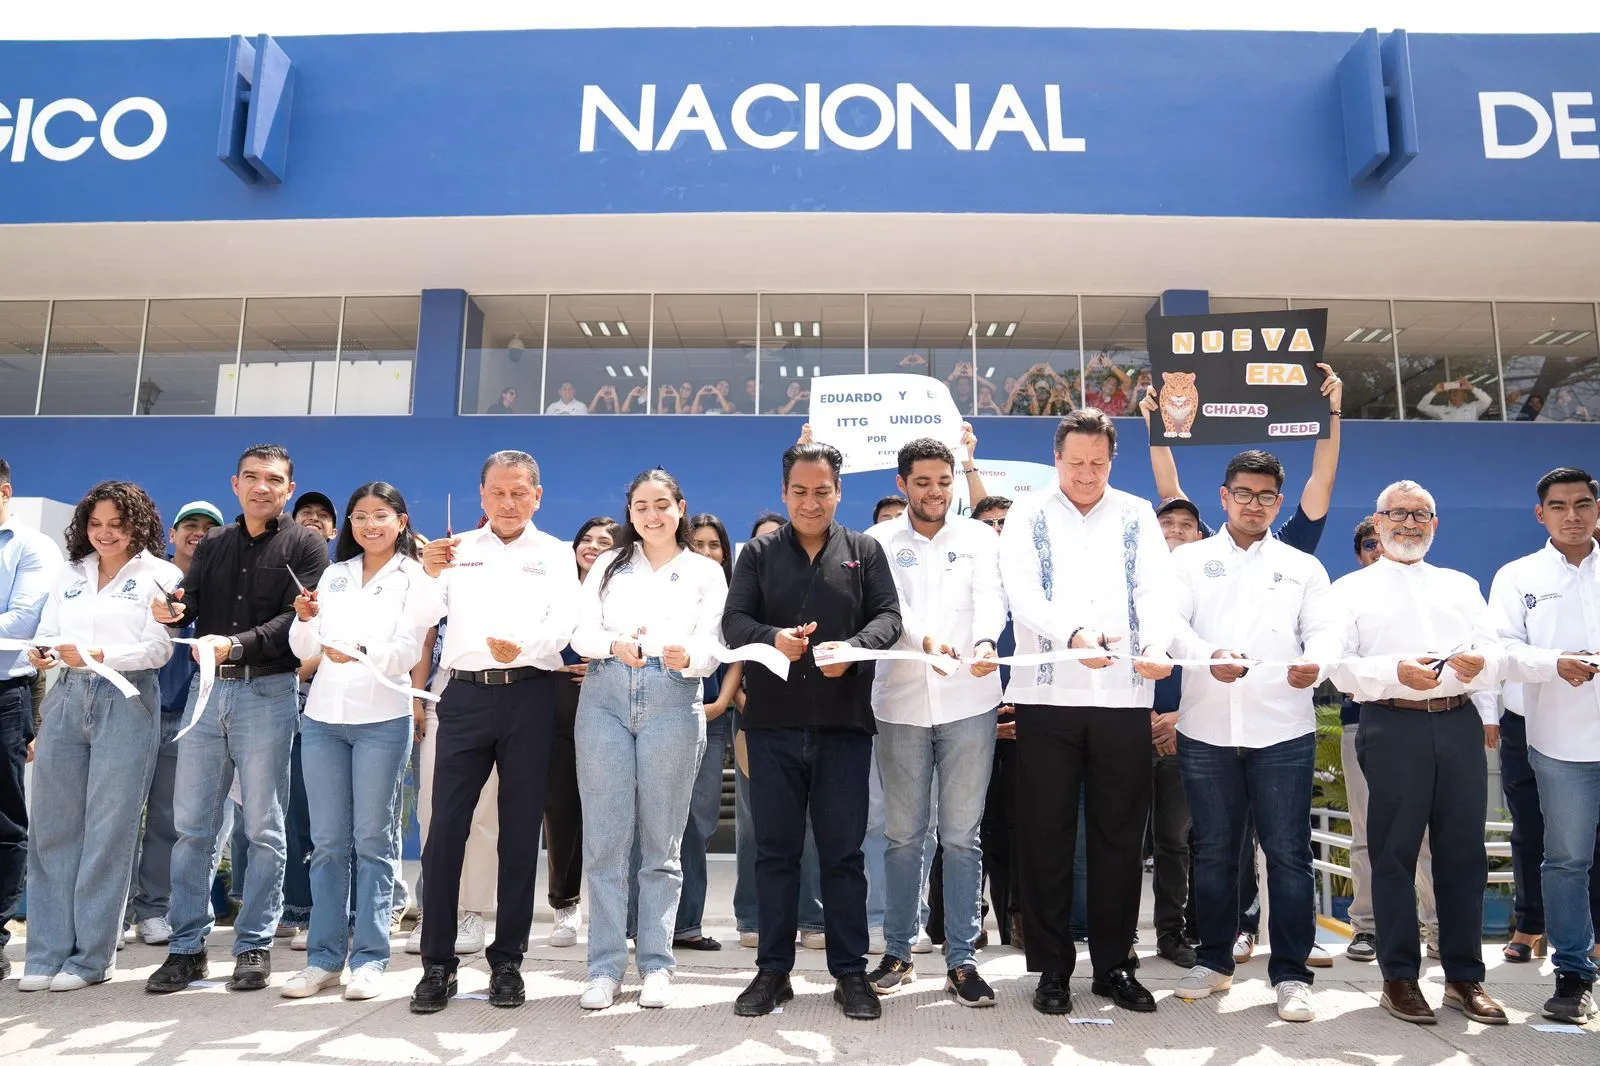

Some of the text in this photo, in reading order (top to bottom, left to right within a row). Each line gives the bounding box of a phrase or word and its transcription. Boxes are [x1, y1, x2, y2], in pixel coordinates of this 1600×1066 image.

[0, 83, 1600, 162] ICO NACIONAL DE
[1172, 328, 1314, 354] NUEVA
[1246, 363, 1307, 385] ERA
[820, 392, 882, 403] EDUARDO
[898, 390, 907, 400] Y
[1203, 404, 1267, 416] CHIAPAS
[837, 414, 942, 427] ITTG UNIDOS
[1270, 423, 1318, 435] PUEDE
[867, 435, 887, 443] POR
